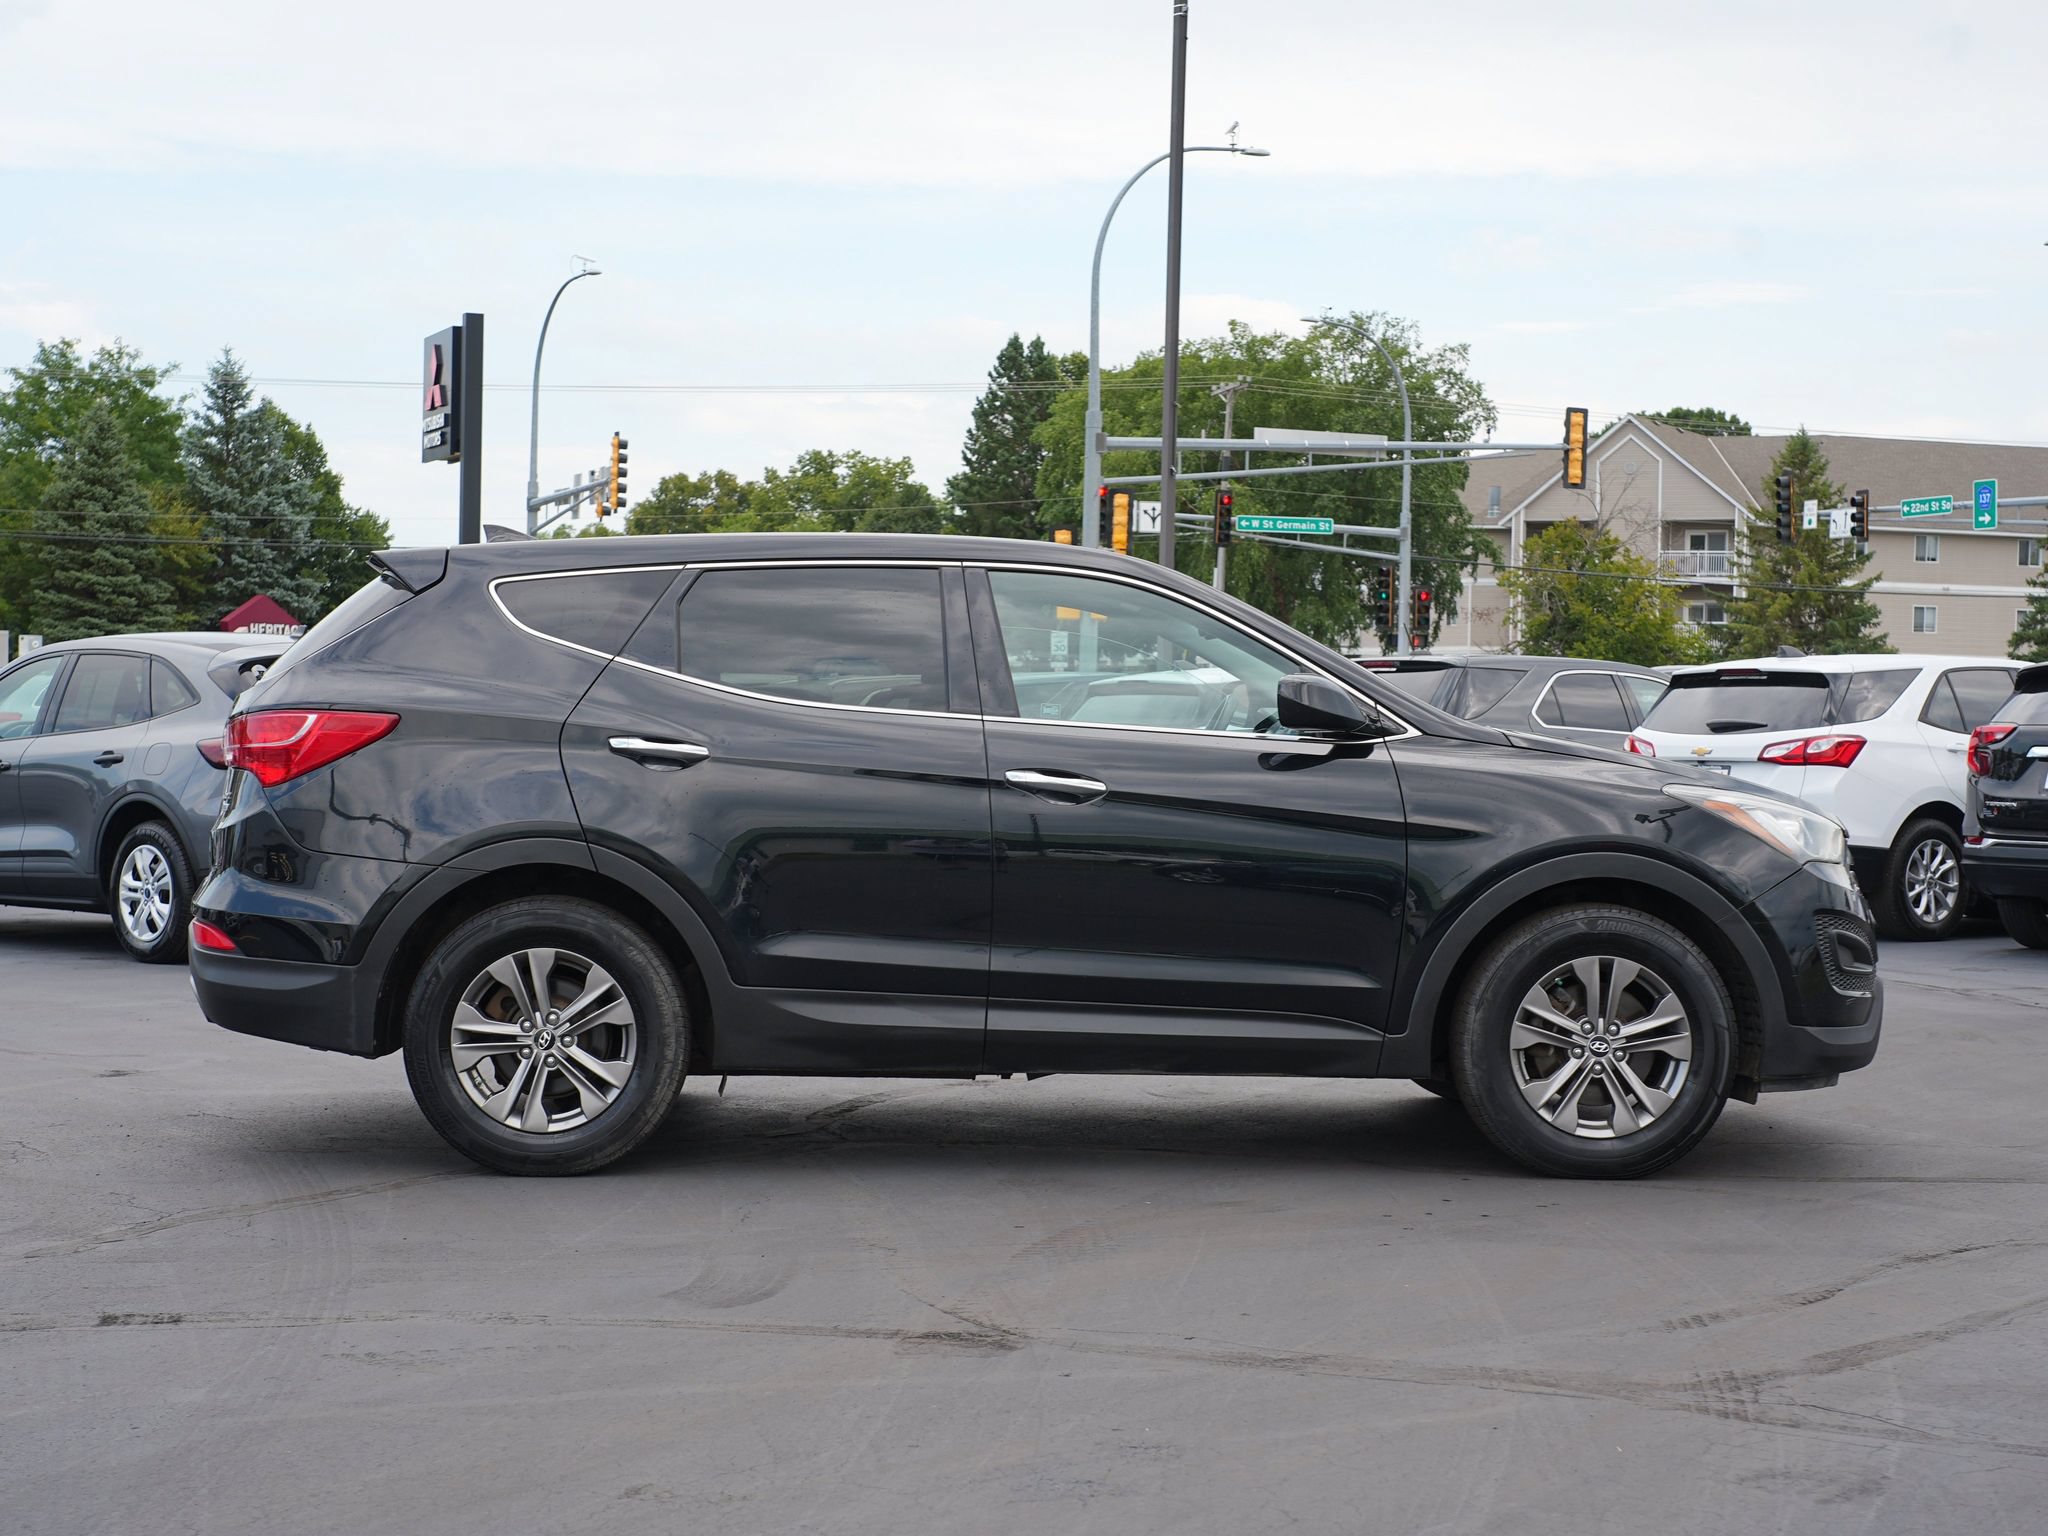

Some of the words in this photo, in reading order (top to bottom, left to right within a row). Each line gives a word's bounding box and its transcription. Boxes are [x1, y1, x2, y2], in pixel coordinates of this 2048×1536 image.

[1979, 493, 1991, 504] 137
[1910, 502, 1930, 513] 22nd
[1930, 500, 1940, 511] St
[1941, 499, 1951, 510] So
[1251, 519, 1260, 528] W
[1262, 519, 1274, 529] St
[1276, 520, 1316, 530] Germain
[1319, 521, 1330, 531] St
[1053, 644, 1066, 652] 30
